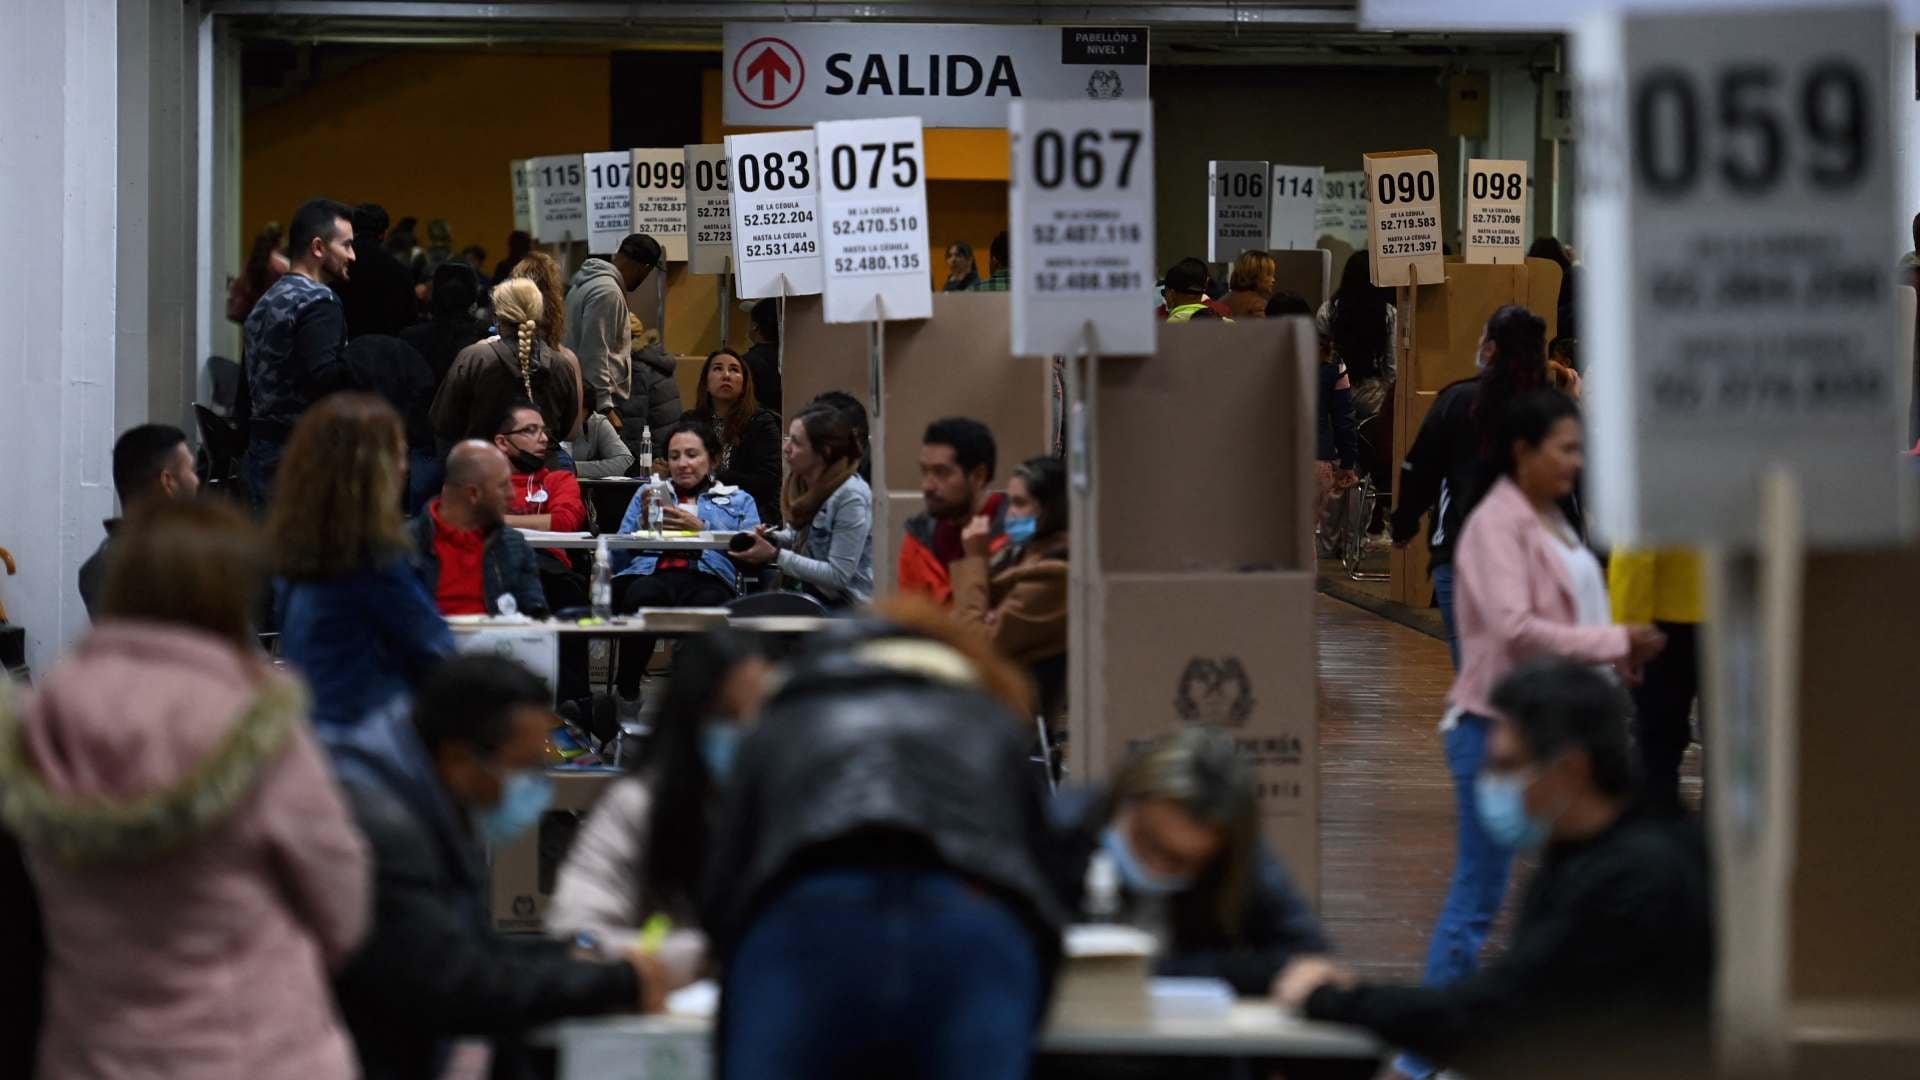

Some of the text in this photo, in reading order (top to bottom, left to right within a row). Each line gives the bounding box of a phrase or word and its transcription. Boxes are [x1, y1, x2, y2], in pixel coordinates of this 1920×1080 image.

[1075, 31, 1137, 43] PABELLÓN 3
[1087, 45, 1125, 55] NIVEL 1
[825, 52, 1022, 97] SALIDA
[1635, 56, 1872, 197] 059
[832, 142, 918, 191] 075
[1033, 128, 1142, 190] 067
[541, 163, 581, 187] 115
[591, 162, 630, 189] 107
[636, 162, 685, 189] 099
[696, 159, 729, 191] 09
[738, 150, 810, 193] 083
[1218, 172, 1263, 198] 106
[1276, 175, 1314, 198] 114
[1325, 180, 1344, 199] 30
[1349, 181, 1368, 200] 12
[1378, 170, 1435, 204] 090
[1472, 172, 1522, 200] 098
[639, 202, 687, 212] 52.762.837
[697, 207, 731, 218] 52.721
[860, 207, 869, 215] LA
[639, 223, 687, 233] 52.770.471
[744, 210, 814, 227] 52.522.204
[832, 216, 918, 235] 52.470.510
[1381, 217, 1437, 230] 52.719.583
[1472, 214, 1521, 224] 52.757.096
[698, 231, 732, 242] 52.723
[753, 233, 772, 242] HASTA
[773, 233, 781, 241] LA
[1471, 235, 1520, 245] 52.762.835
[746, 240, 816, 257] 52.531.449
[843, 245, 866, 253] HASTA
[869, 244, 877, 252] LA
[1382, 241, 1437, 254] 52.721.397
[834, 253, 920, 272] 52.480.135
